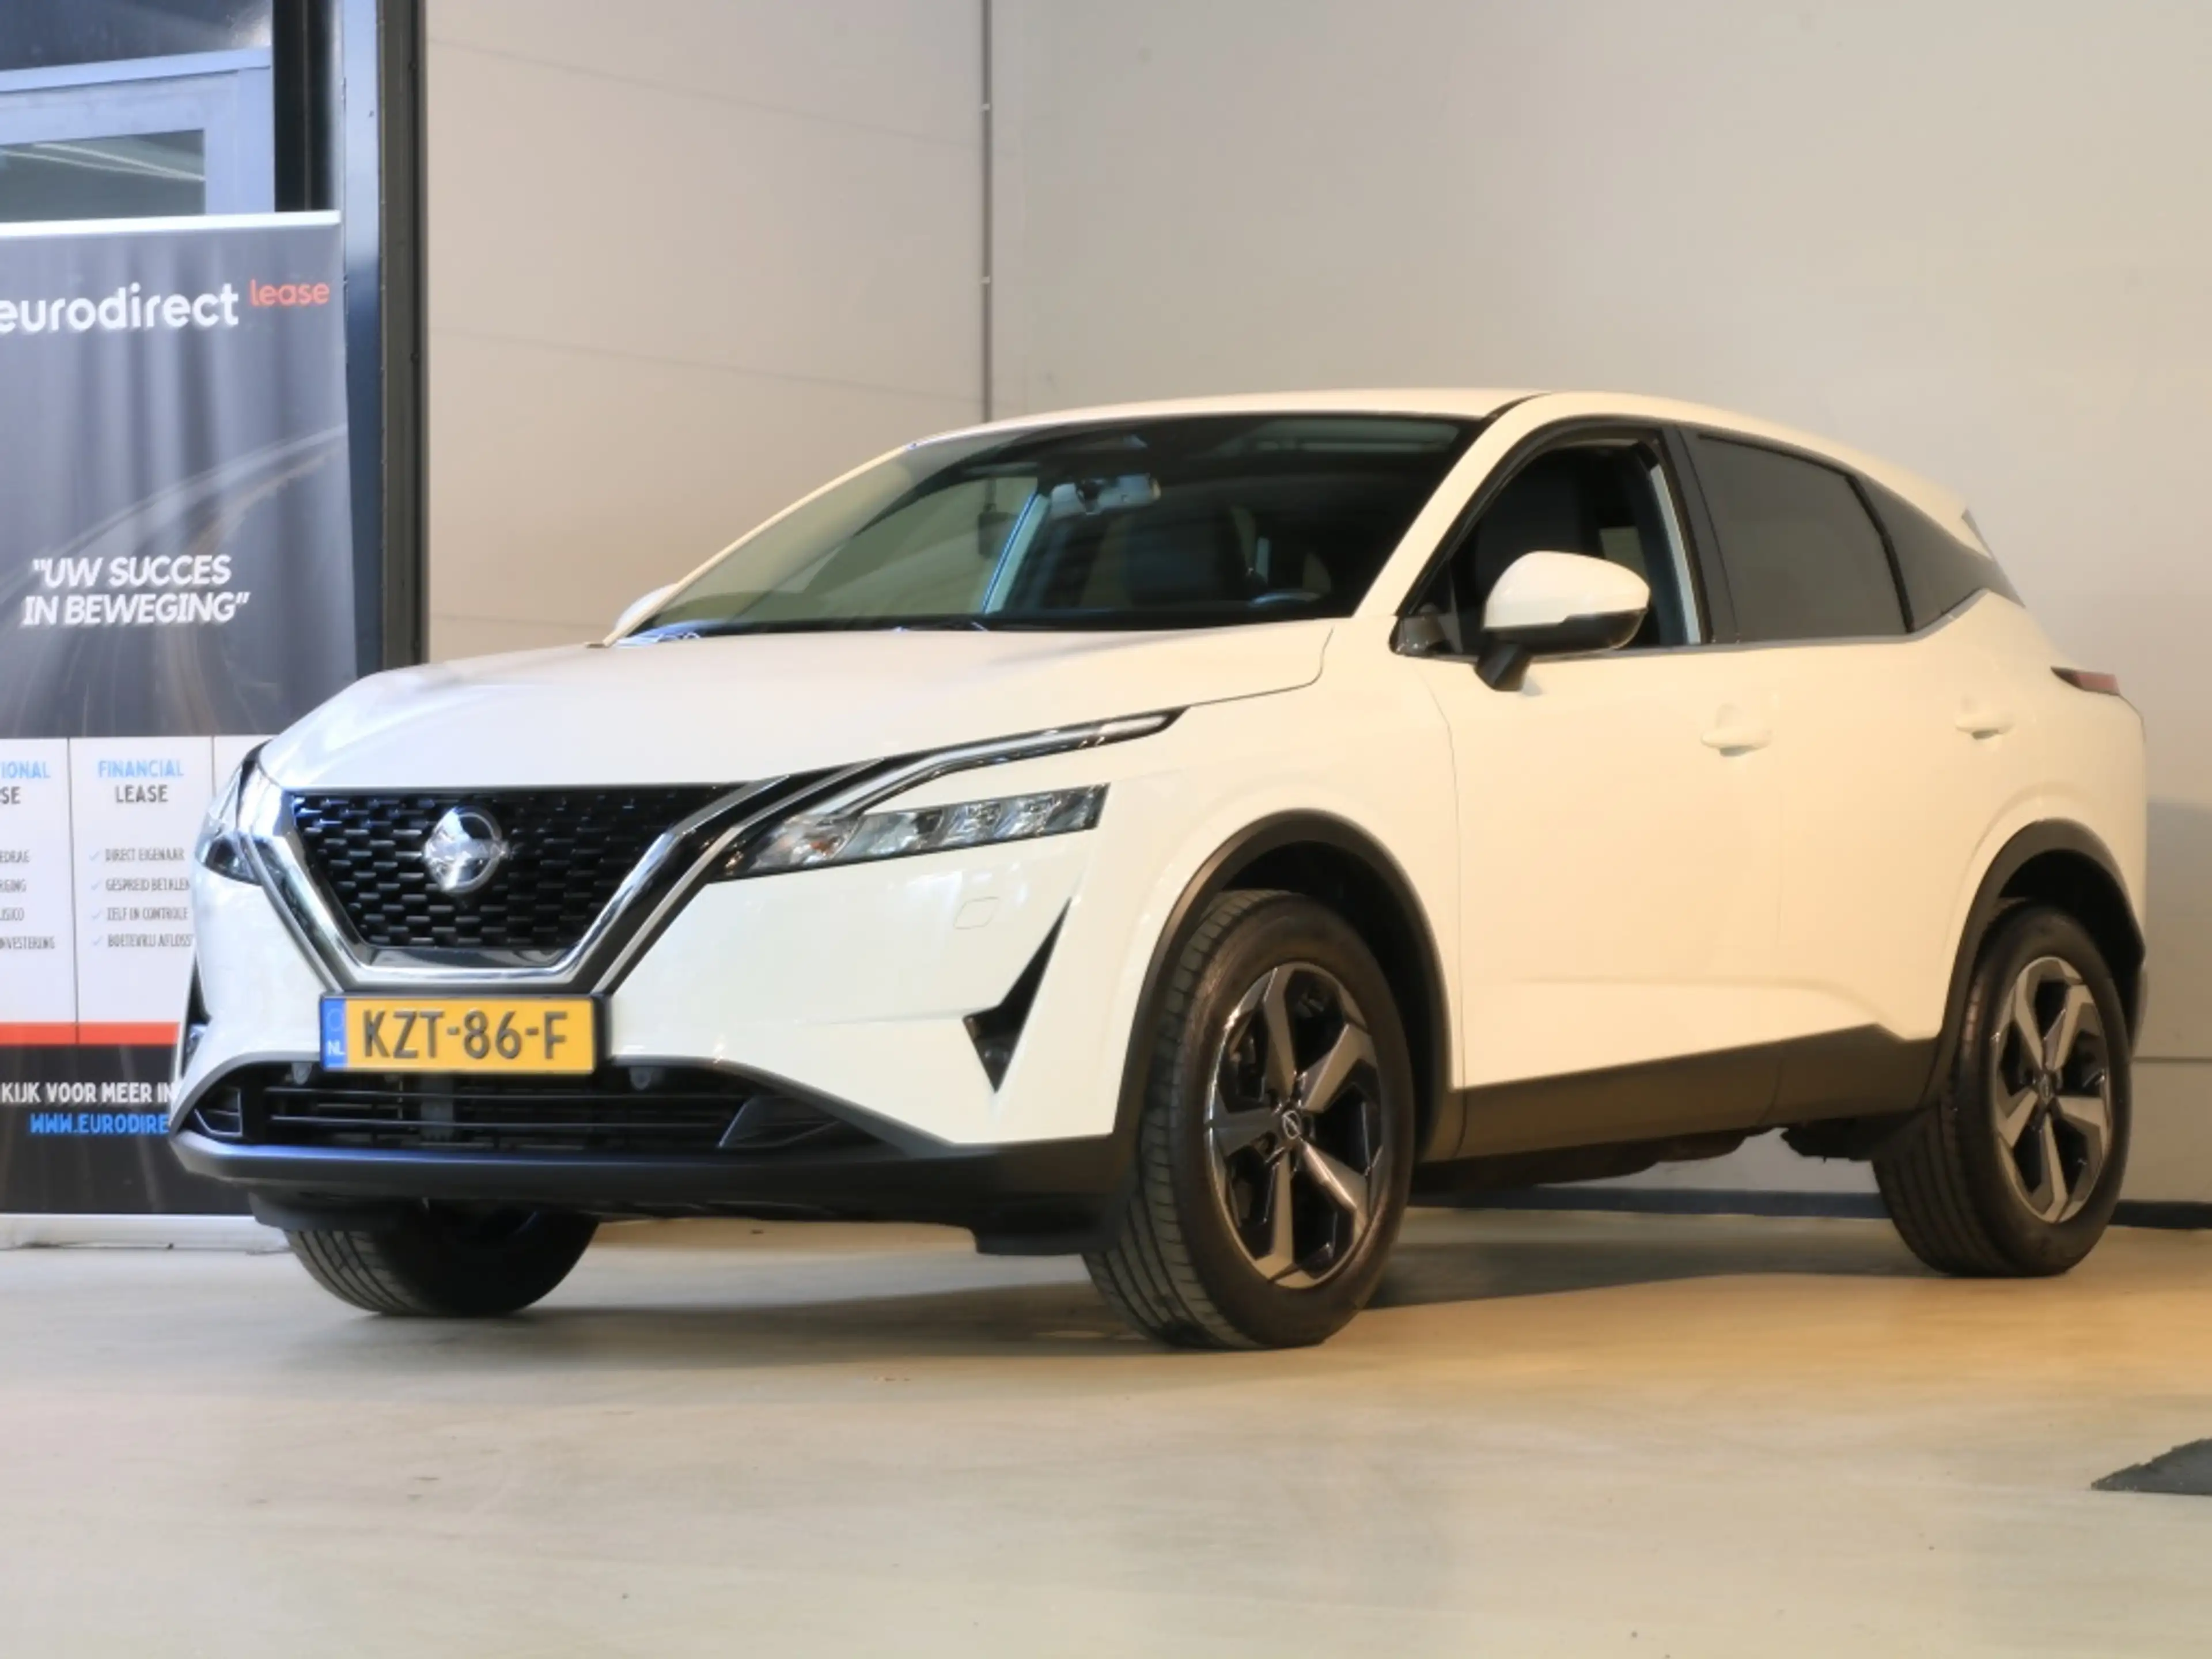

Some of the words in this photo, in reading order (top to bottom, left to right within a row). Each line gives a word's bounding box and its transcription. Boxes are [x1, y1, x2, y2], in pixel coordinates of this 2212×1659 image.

[0, 282, 239, 333] eurodirect
[249, 279, 329, 306] lease
[108, 555, 232, 586] SUCCES
[22, 595, 59, 626] IN
[64, 592, 250, 624] BEWEGING"
[97, 759, 184, 779] FINANCIAL
[115, 784, 168, 804] LEASE
[105, 847, 136, 862] DIRECT
[138, 847, 185, 861] EIGENAAR
[107, 907, 127, 921] ZELF
[142, 906, 188, 921] CONTROLE
[363, 1008, 568, 1060] KZT-86-F
[327, 1041, 344, 1056] NL
[2, 1082, 42, 1103] KIJK
[46, 1082, 97, 1103] VOOR
[101, 1082, 152, 1103] MEER
